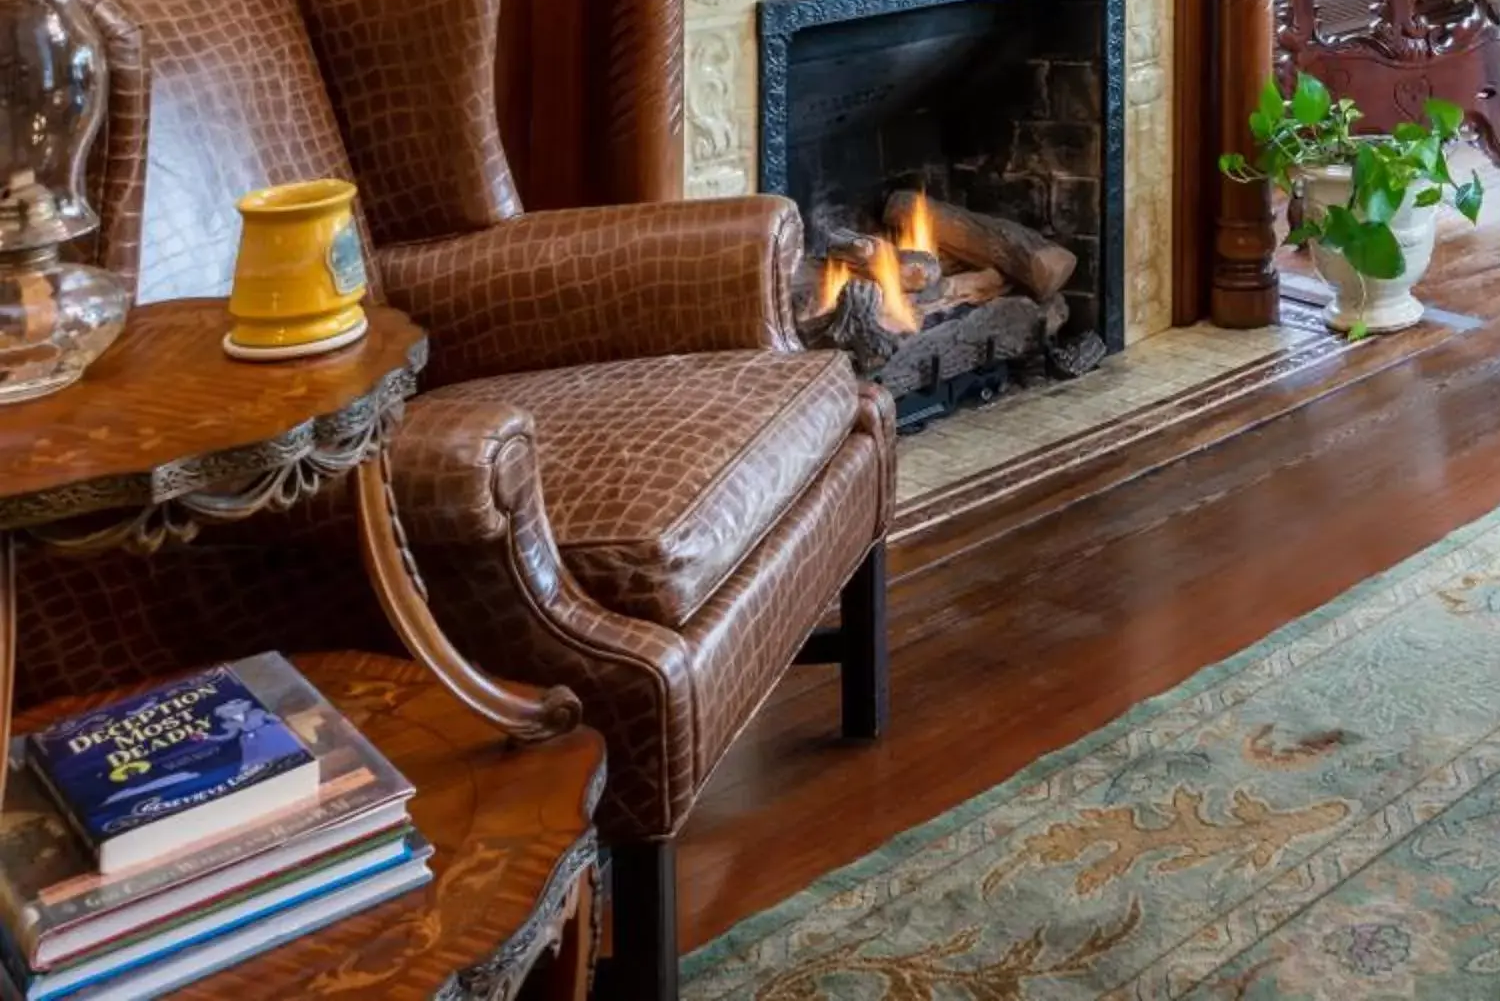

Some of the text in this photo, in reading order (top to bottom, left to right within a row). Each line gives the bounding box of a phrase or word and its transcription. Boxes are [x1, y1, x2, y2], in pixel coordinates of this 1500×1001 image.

[68, 682, 218, 754] DECEPTION
[106, 716, 211, 767] DEADLY
[114, 708, 194, 750] MOST
